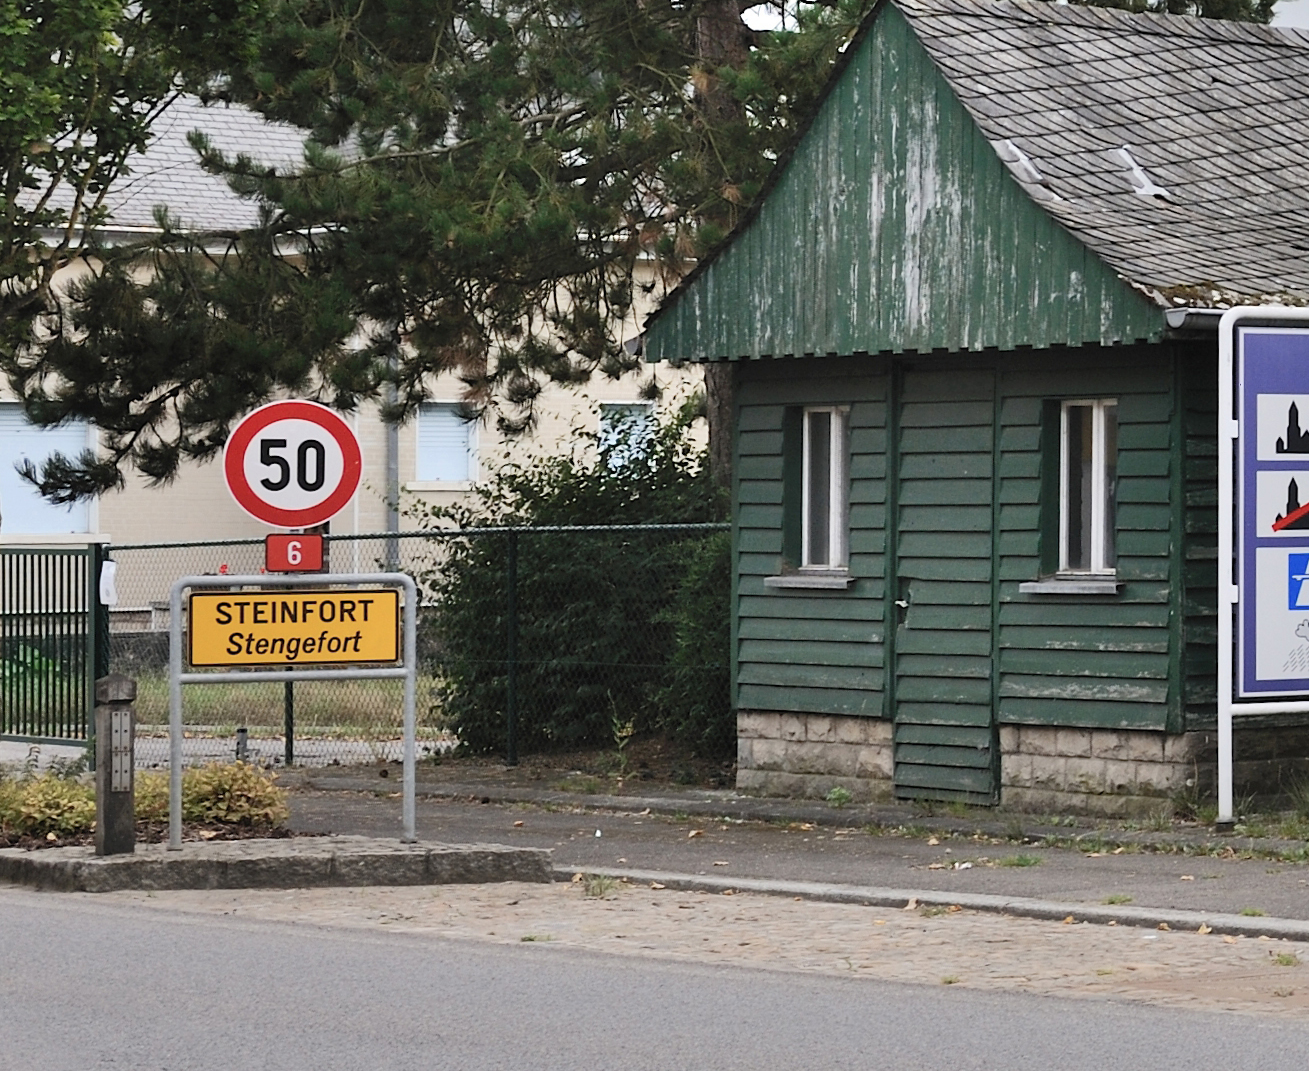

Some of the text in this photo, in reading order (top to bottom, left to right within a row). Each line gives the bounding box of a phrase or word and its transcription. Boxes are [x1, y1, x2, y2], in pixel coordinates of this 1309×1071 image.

[258, 438, 326, 492] 50
[286, 541, 302, 565] 6
[215, 598, 375, 626] STEINFORT
[226, 629, 363, 661] Stengefort
